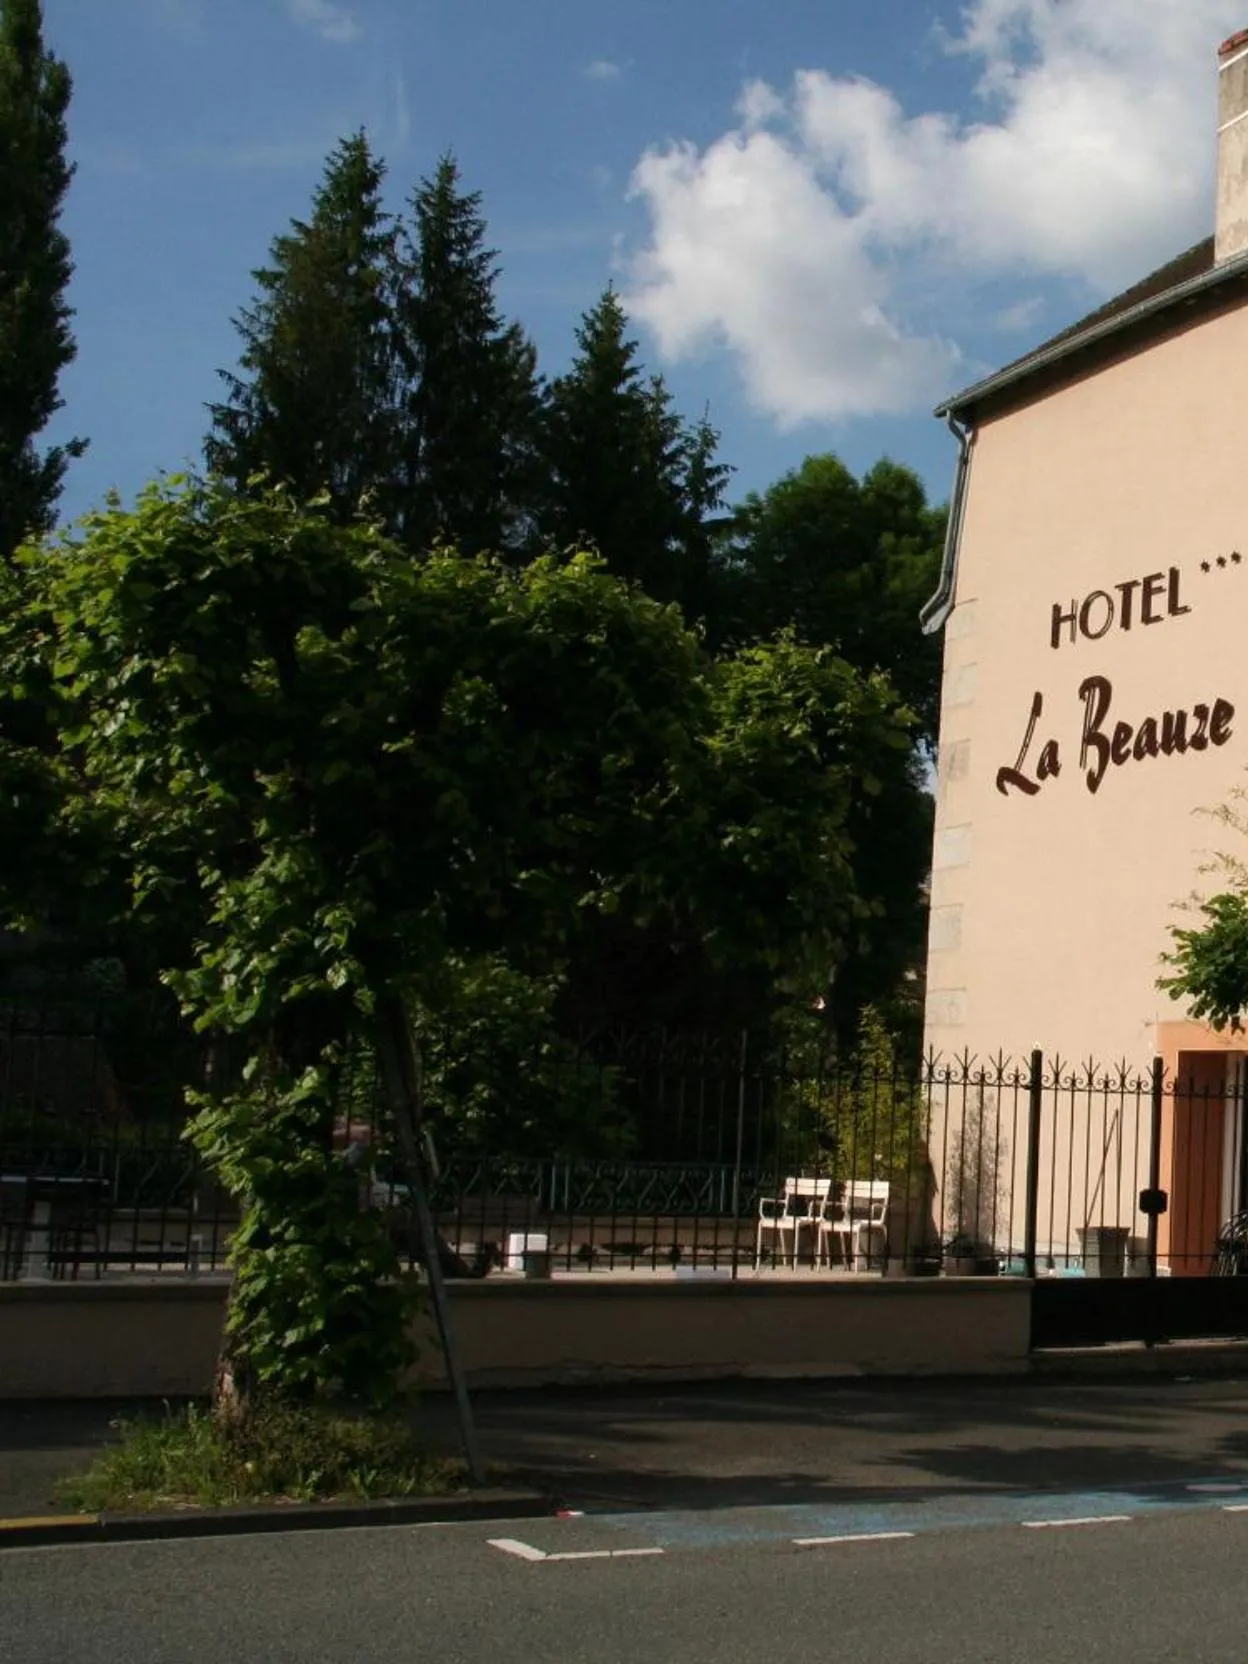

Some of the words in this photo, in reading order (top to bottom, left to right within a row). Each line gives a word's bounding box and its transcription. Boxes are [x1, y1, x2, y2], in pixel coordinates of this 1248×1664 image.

[1051, 567, 1192, 649] HOTEL
[996, 691, 1062, 796] La
[1078, 675, 1235, 794] Beauze
